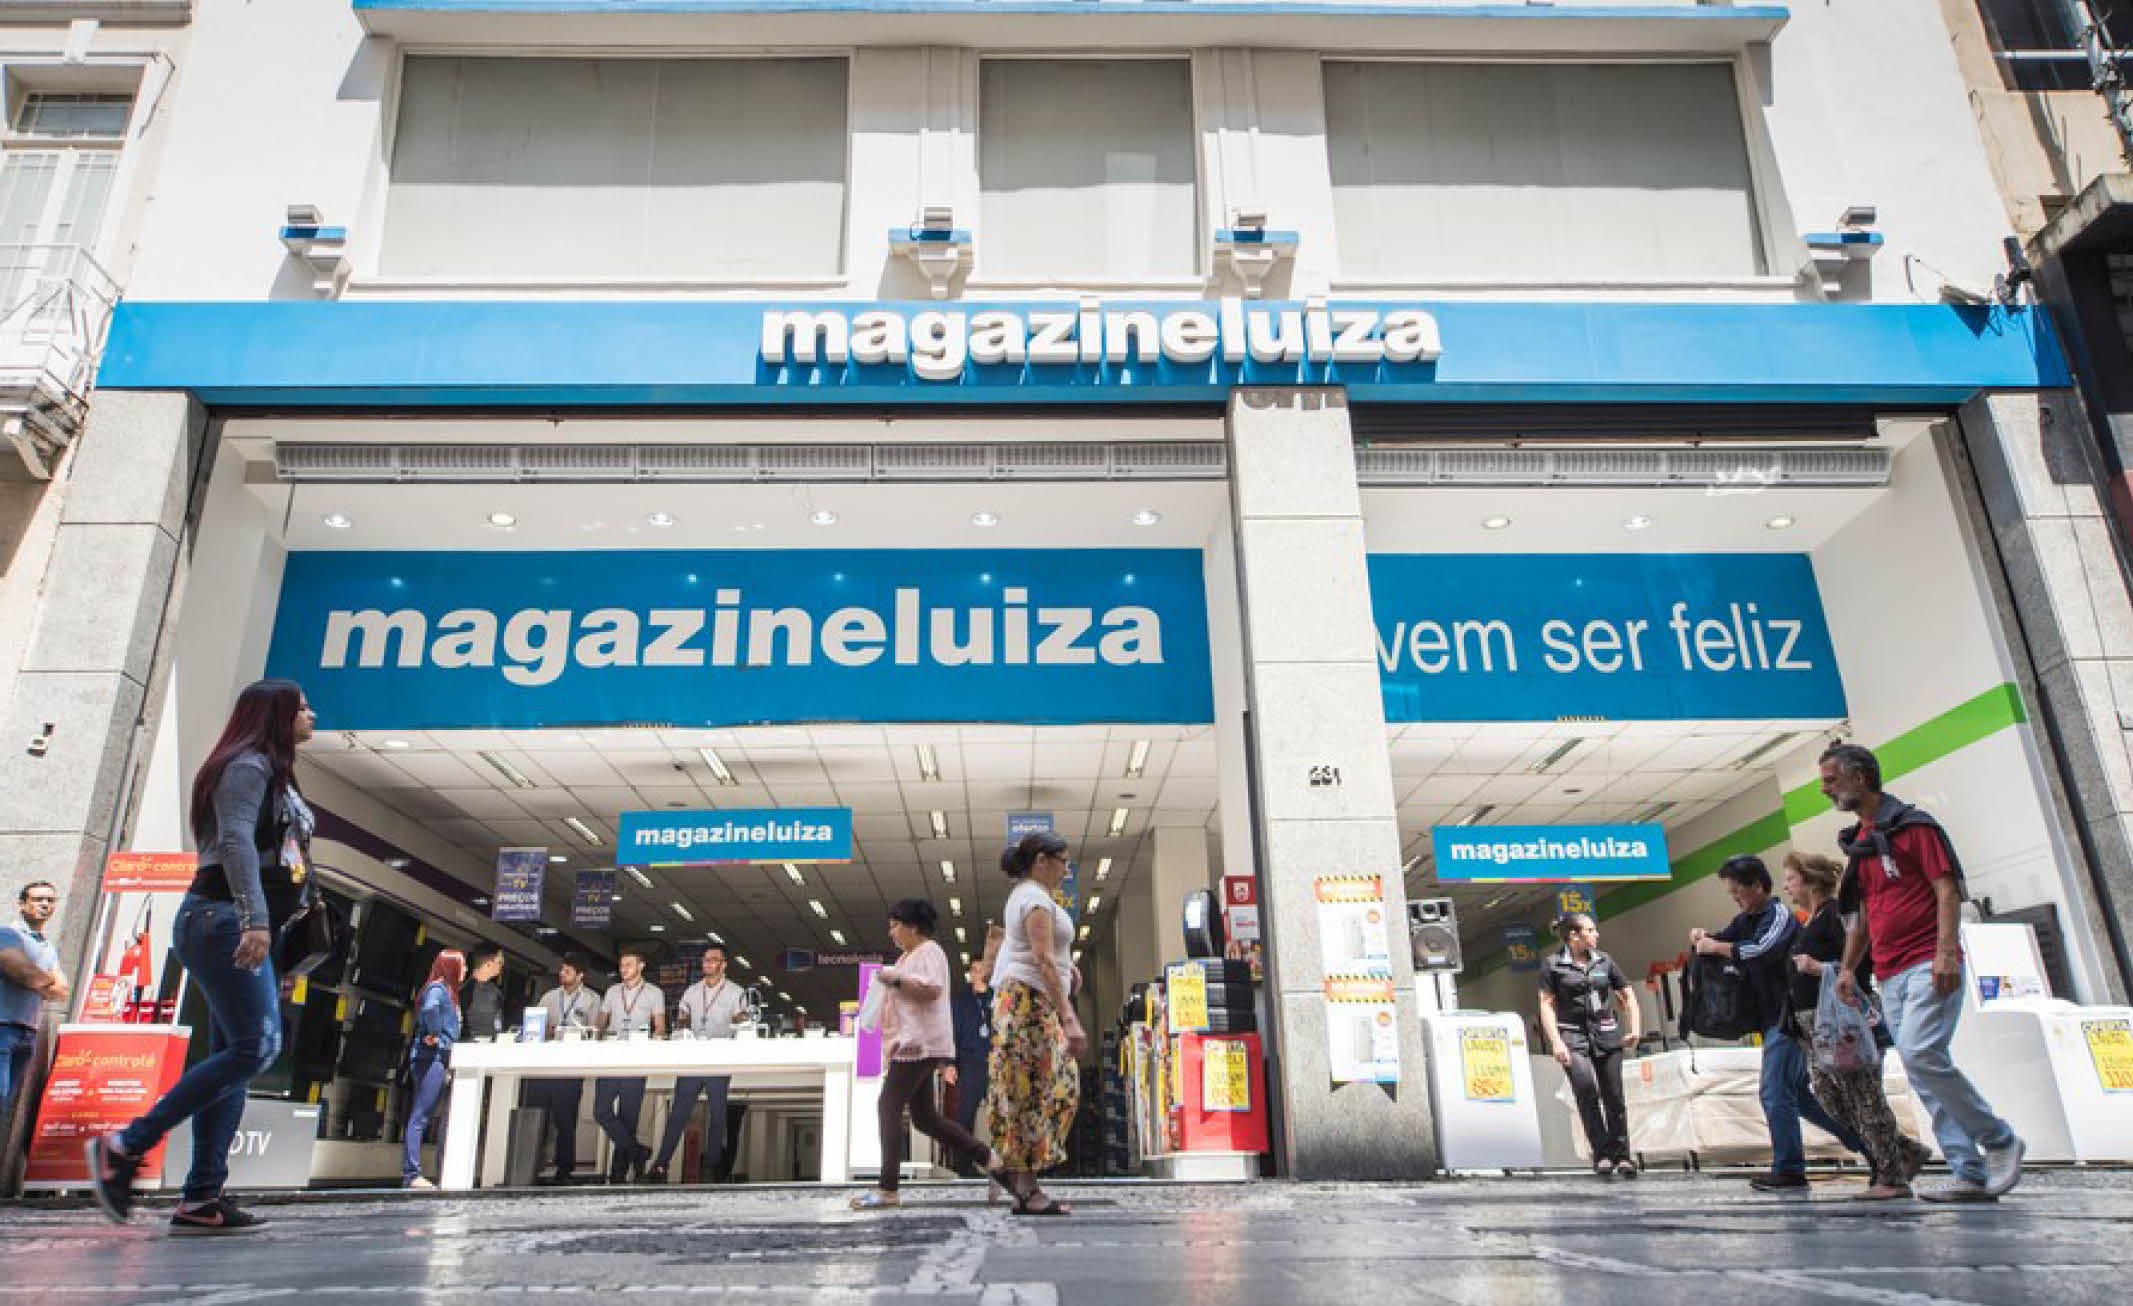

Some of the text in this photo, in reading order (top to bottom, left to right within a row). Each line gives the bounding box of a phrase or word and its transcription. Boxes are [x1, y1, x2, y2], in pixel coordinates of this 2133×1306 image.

[762, 296, 1441, 380] magazineluiza
[321, 588, 1163, 686] magazineluiza
[1376, 602, 1814, 674] vem ser feliz
[635, 821, 833, 848] magazineluiza
[1451, 837, 1648, 865] magazineluiza
